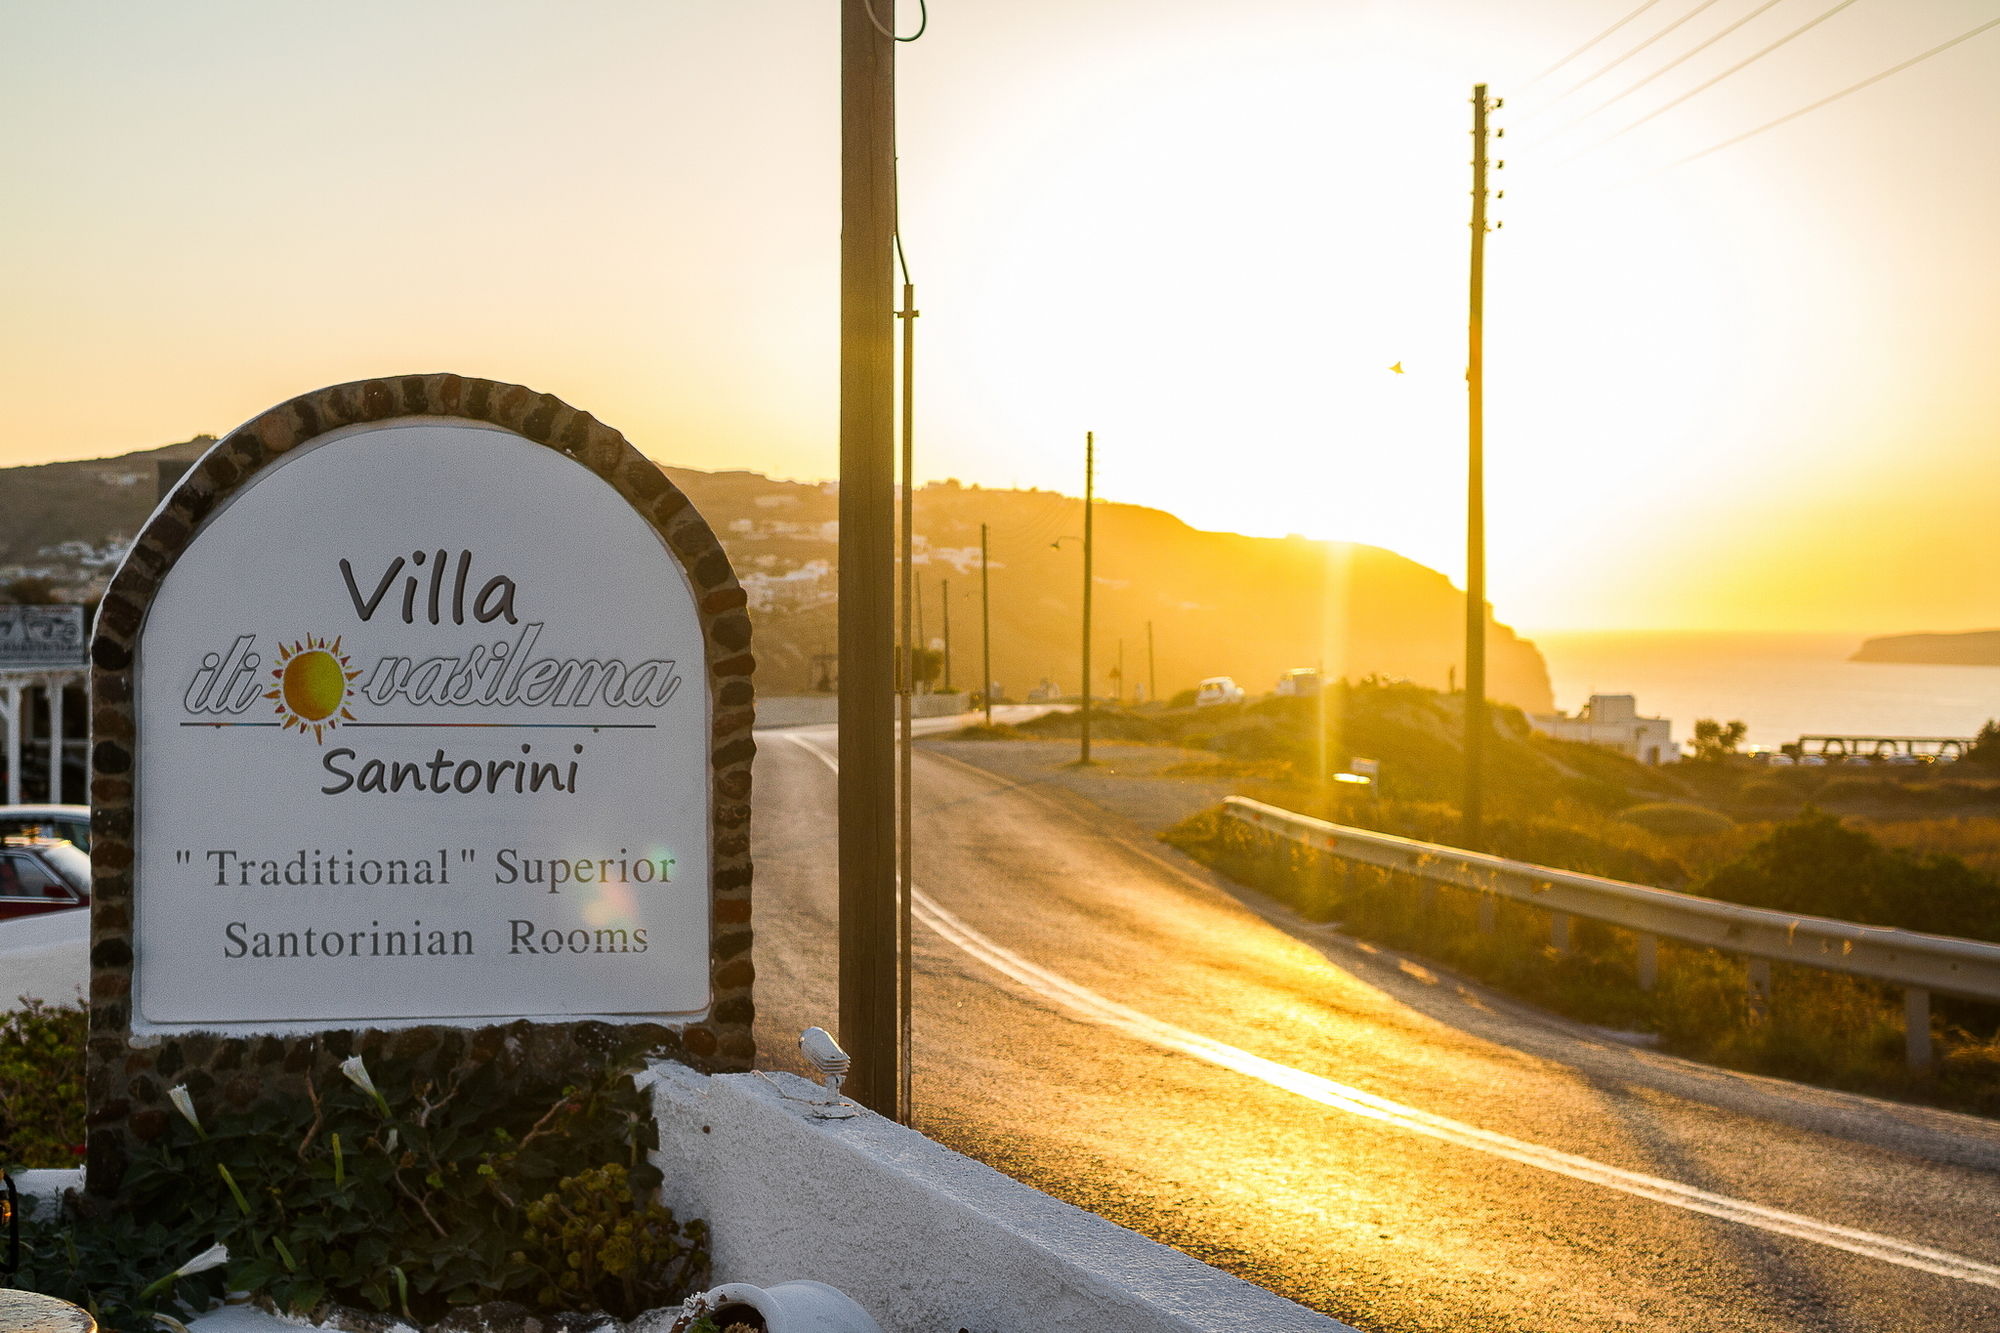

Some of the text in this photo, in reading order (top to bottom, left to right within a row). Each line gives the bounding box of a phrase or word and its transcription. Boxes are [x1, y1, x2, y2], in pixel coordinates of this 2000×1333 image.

[339, 549, 518, 624] Villa
[183, 622, 681, 714] ili vasilema
[321, 743, 583, 795] Santorini
[495, 848, 676, 893] Superior
[224, 919, 648, 958] Santorinian Rooms
